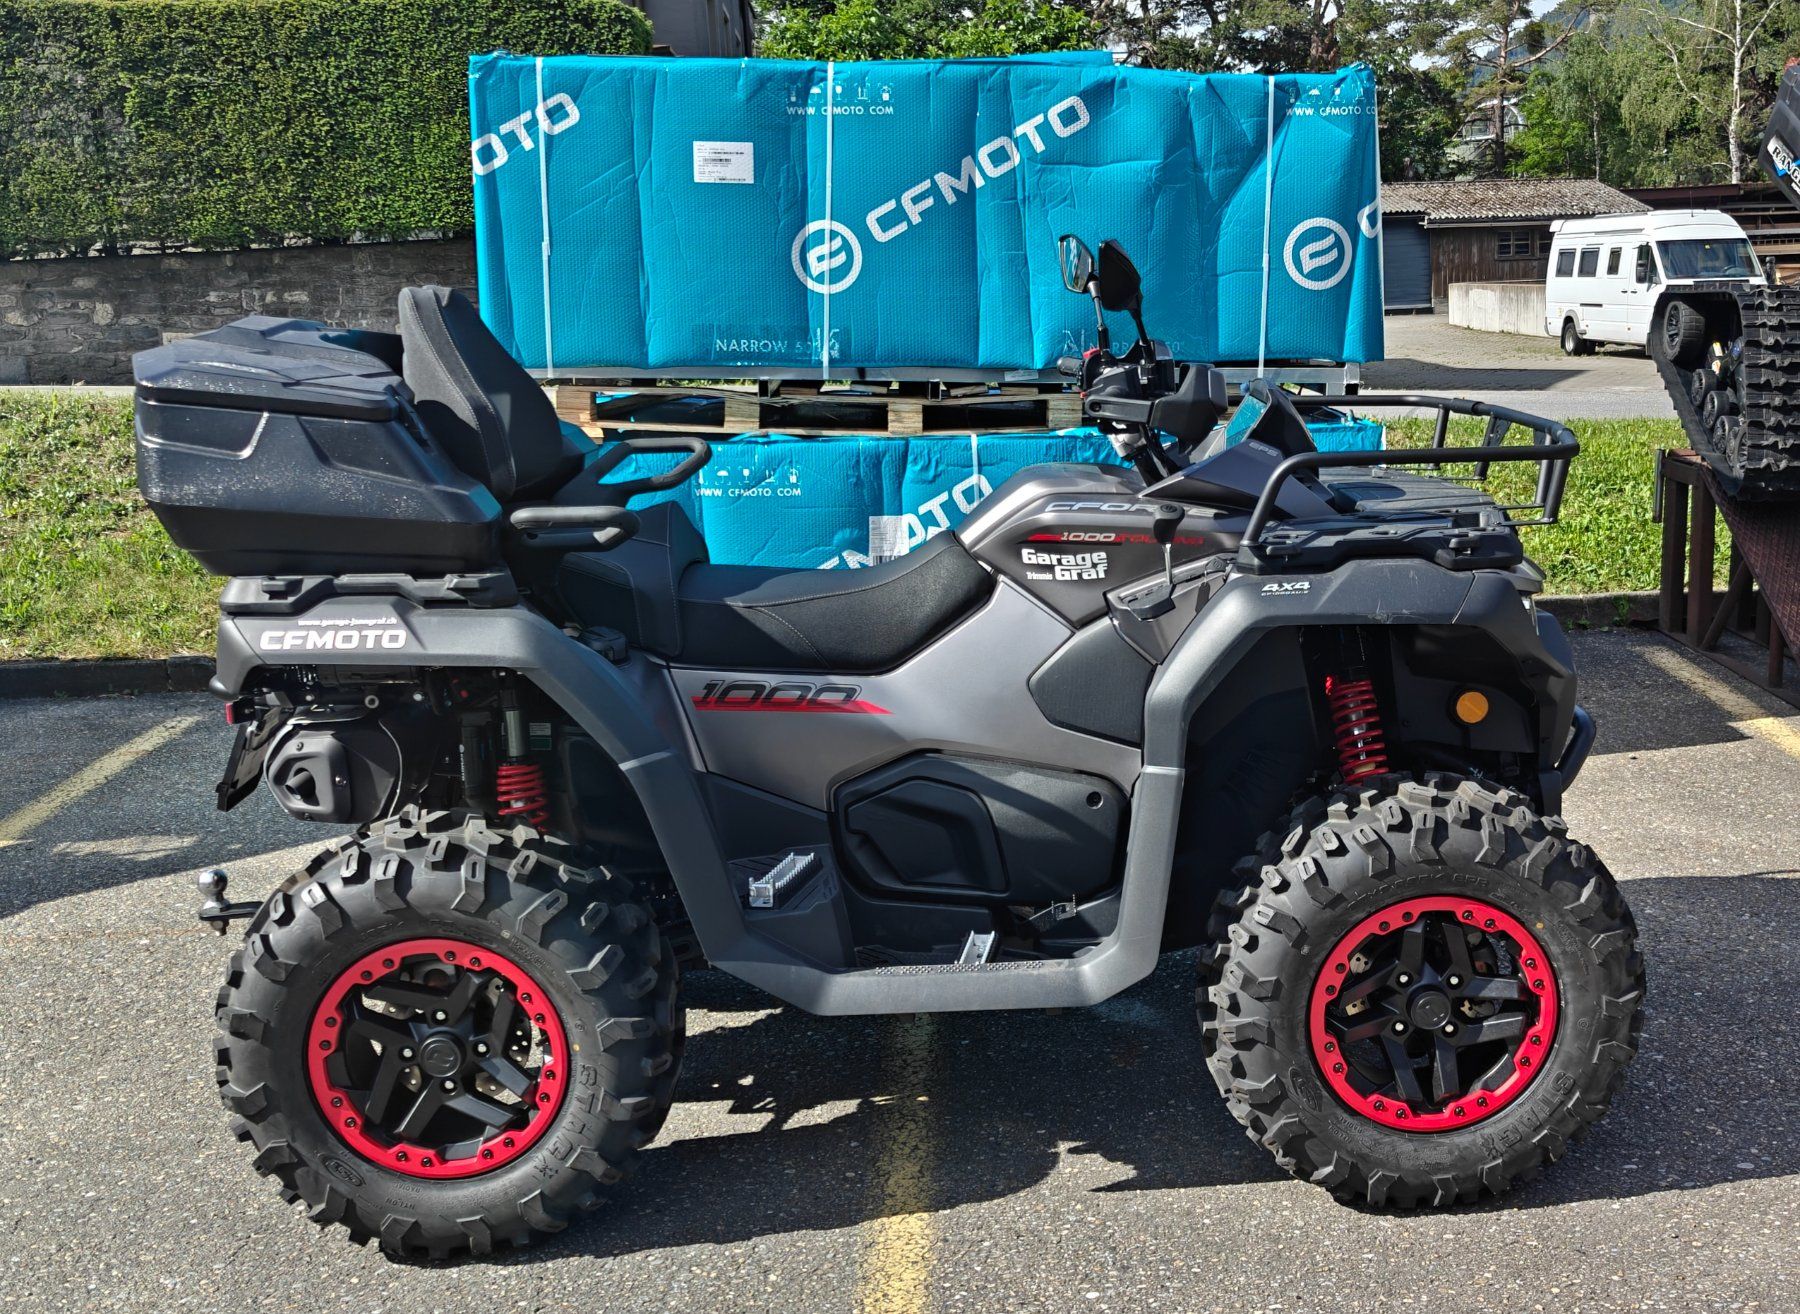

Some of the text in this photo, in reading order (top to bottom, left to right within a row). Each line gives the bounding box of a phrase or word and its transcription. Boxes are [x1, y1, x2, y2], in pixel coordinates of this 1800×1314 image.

[472, 93, 580, 176] OTO
[866, 95, 1090, 243] CFMOTO
[716, 339, 787, 353] NARROW
[1045, 501, 1229, 518] CFORE
[1061, 532, 1117, 542] 1000
[1021, 548, 1108, 568] Garage
[1054, 563, 1108, 581] Graf
[260, 629, 407, 650] CFMOTO
[701, 680, 862, 705] 1000
